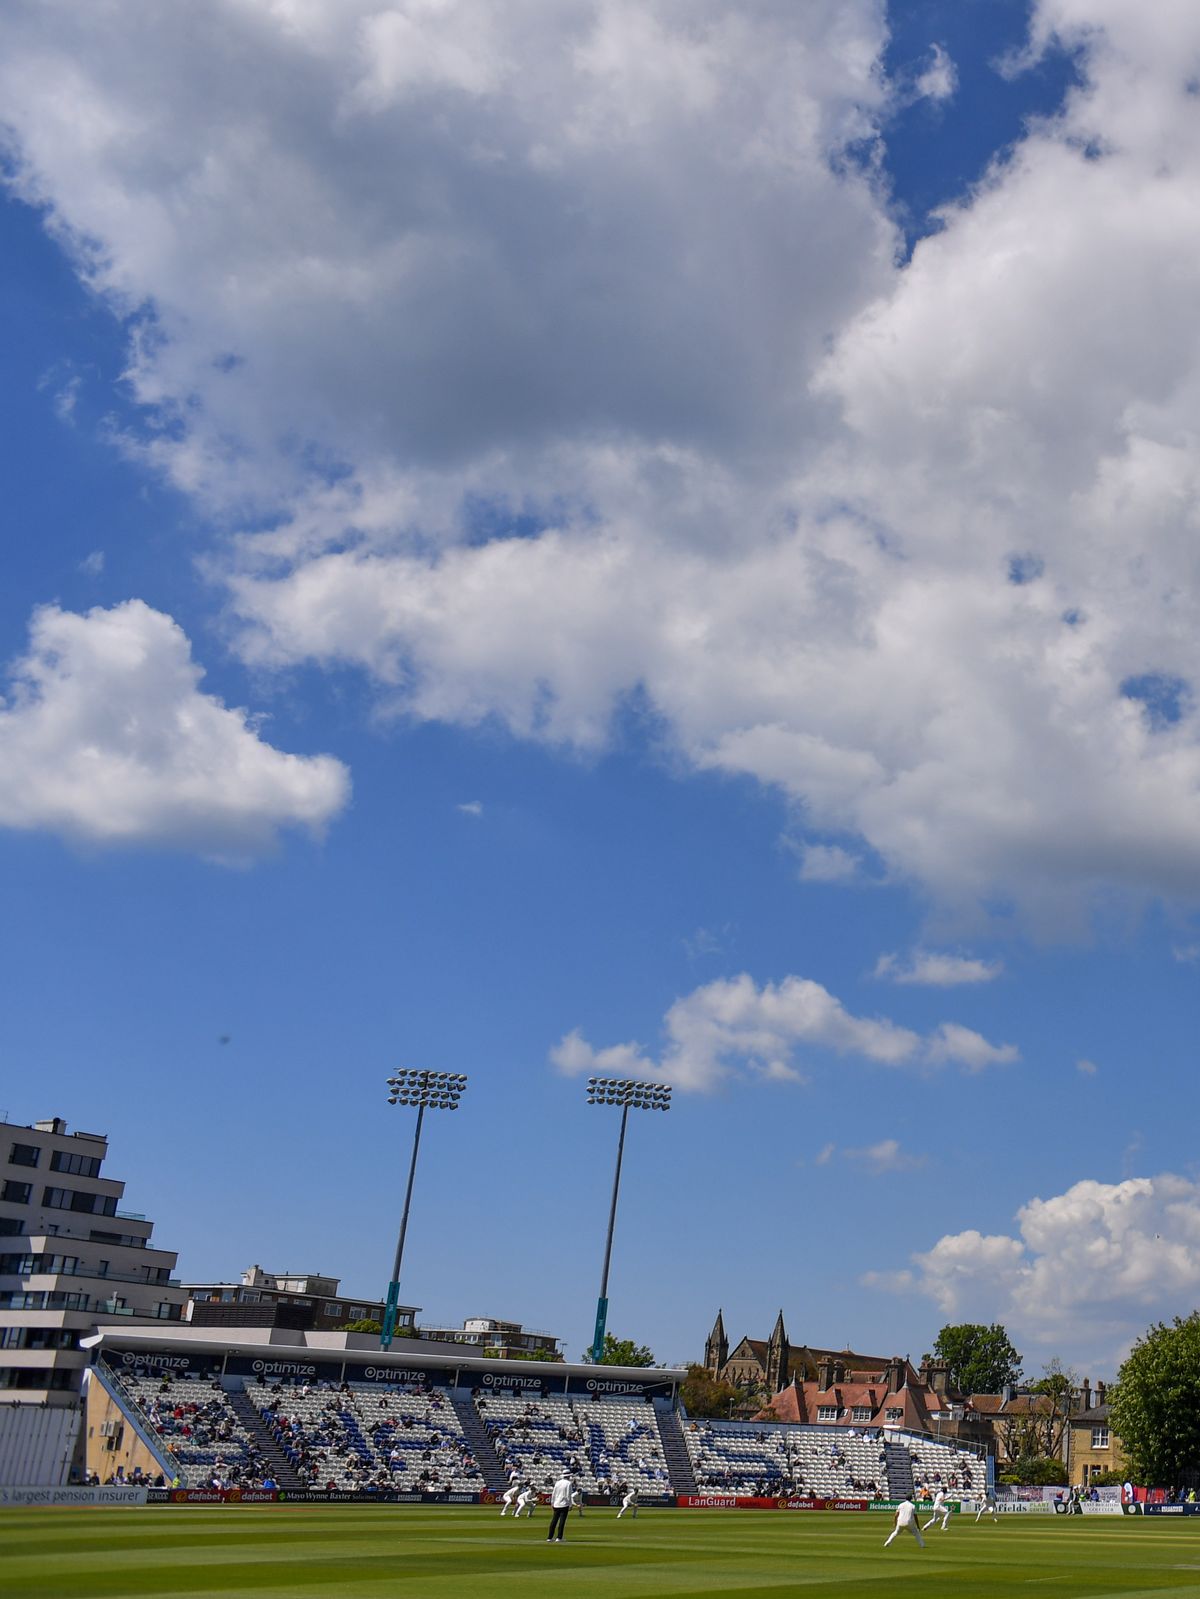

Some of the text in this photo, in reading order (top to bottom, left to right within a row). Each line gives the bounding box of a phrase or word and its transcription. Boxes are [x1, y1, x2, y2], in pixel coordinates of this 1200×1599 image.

[122, 1352, 190, 1368] Optimize
[252, 1360, 316, 1376] Optimize
[364, 1366, 426, 1382] Optimize
[482, 1374, 542, 1388] Optimize
[586, 1379, 644, 1393] Optimize
[12, 1490, 50, 1503] largest
[53, 1490, 94, 1502] pension
[100, 1490, 140, 1501] insurer
[188, 1491, 221, 1500] dafabet
[242, 1492, 273, 1501] dafabet
[688, 1496, 736, 1507] LanGuard
[787, 1501, 814, 1509] dafabet
